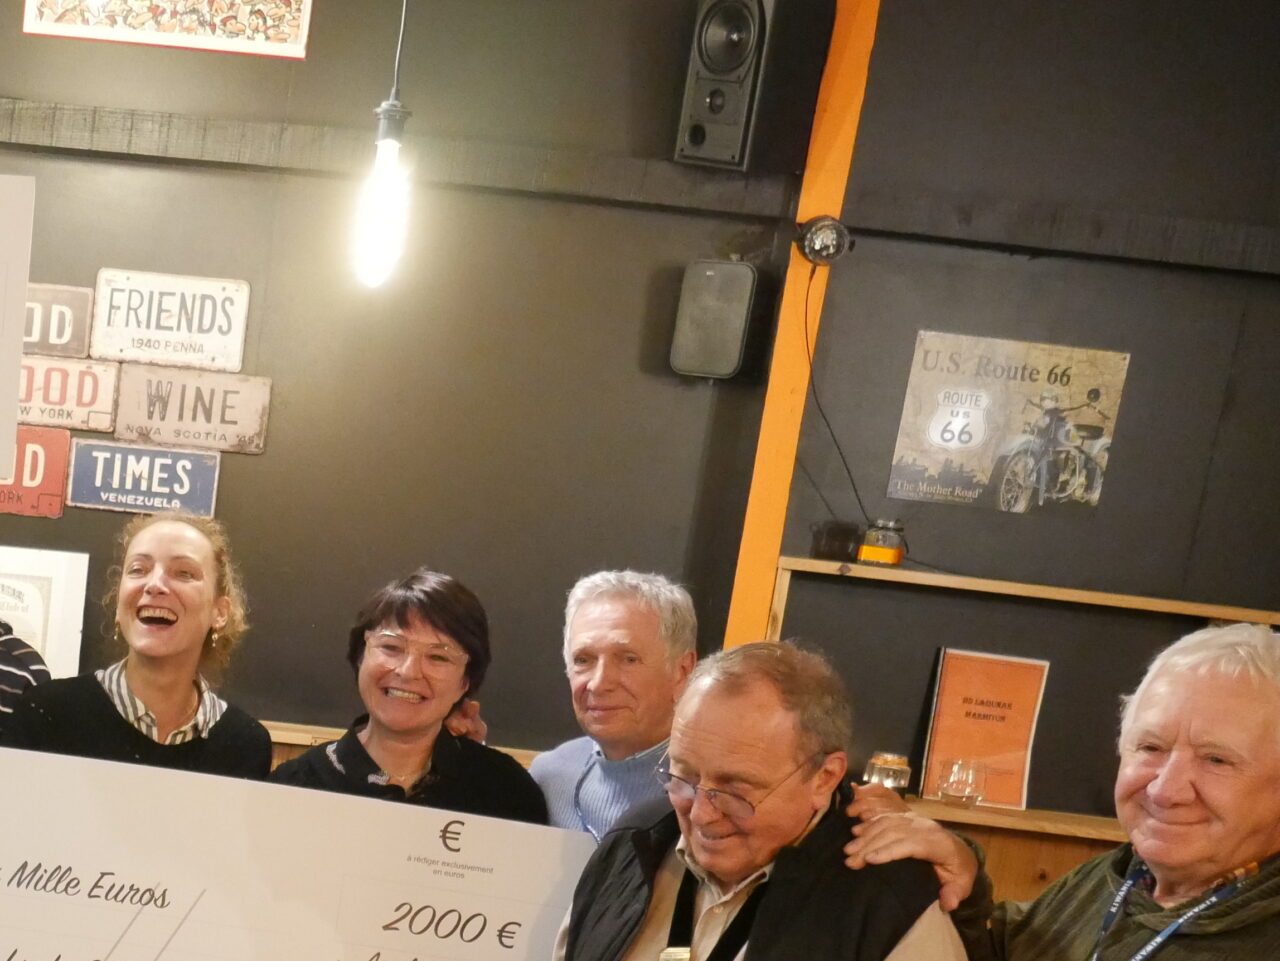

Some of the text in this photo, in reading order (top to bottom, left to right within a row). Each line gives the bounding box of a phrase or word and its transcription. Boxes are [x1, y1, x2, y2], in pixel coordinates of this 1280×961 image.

[23, 302, 73, 345] OD
[107, 288, 235, 336] FRIENDS
[131, 338, 205, 354] 1940 PENNA
[922, 350, 1073, 387] U.S. Route 66
[18, 365, 99, 408] OOD
[146, 379, 240, 425] WINE
[942, 390, 983, 408] ROUTE
[39, 407, 74, 420] YORK
[126, 424, 227, 442] NOVA SCOTIA
[940, 421, 973, 444] 66
[91, 450, 192, 495] TIMES
[917, 481, 952, 495] Mother
[100, 491, 181, 509] VENEZUELA
[439, 820, 465, 852] €
[7, 861, 81, 896] Mille
[87, 872, 170, 909] Euros
[1110, 879, 1133, 913] KIWANIS
[382, 902, 522, 949] 2000 €
[1176, 896, 1218, 924] KIWANIS
